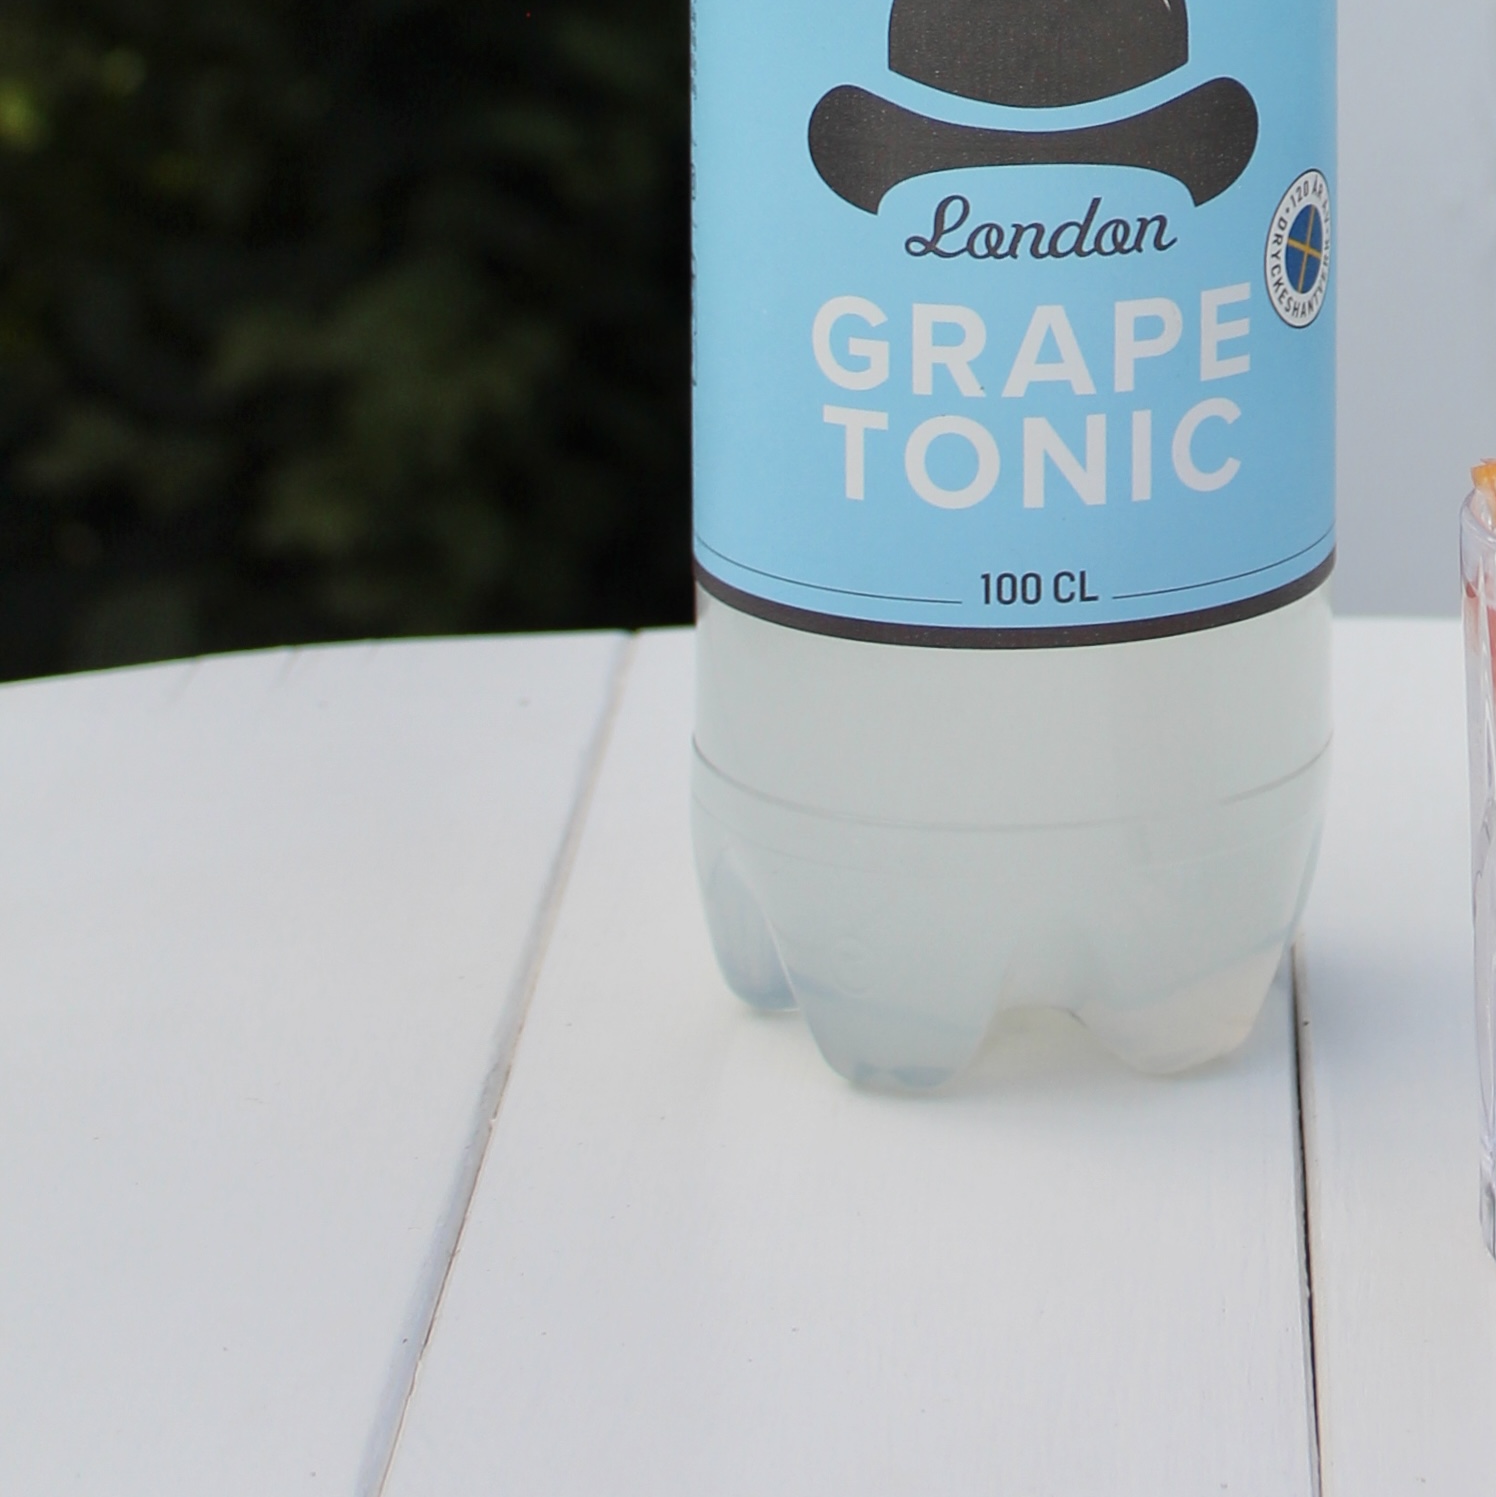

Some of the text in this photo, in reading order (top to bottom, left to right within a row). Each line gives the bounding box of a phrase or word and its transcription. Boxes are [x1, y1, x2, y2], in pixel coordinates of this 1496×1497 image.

[1290, 181, 1309, 207] 120
[905, 195, 1178, 260] London
[811, 282, 1252, 398] GRAPE
[822, 397, 1243, 509] TONIC
[980, 570, 1100, 606] 100 CL
